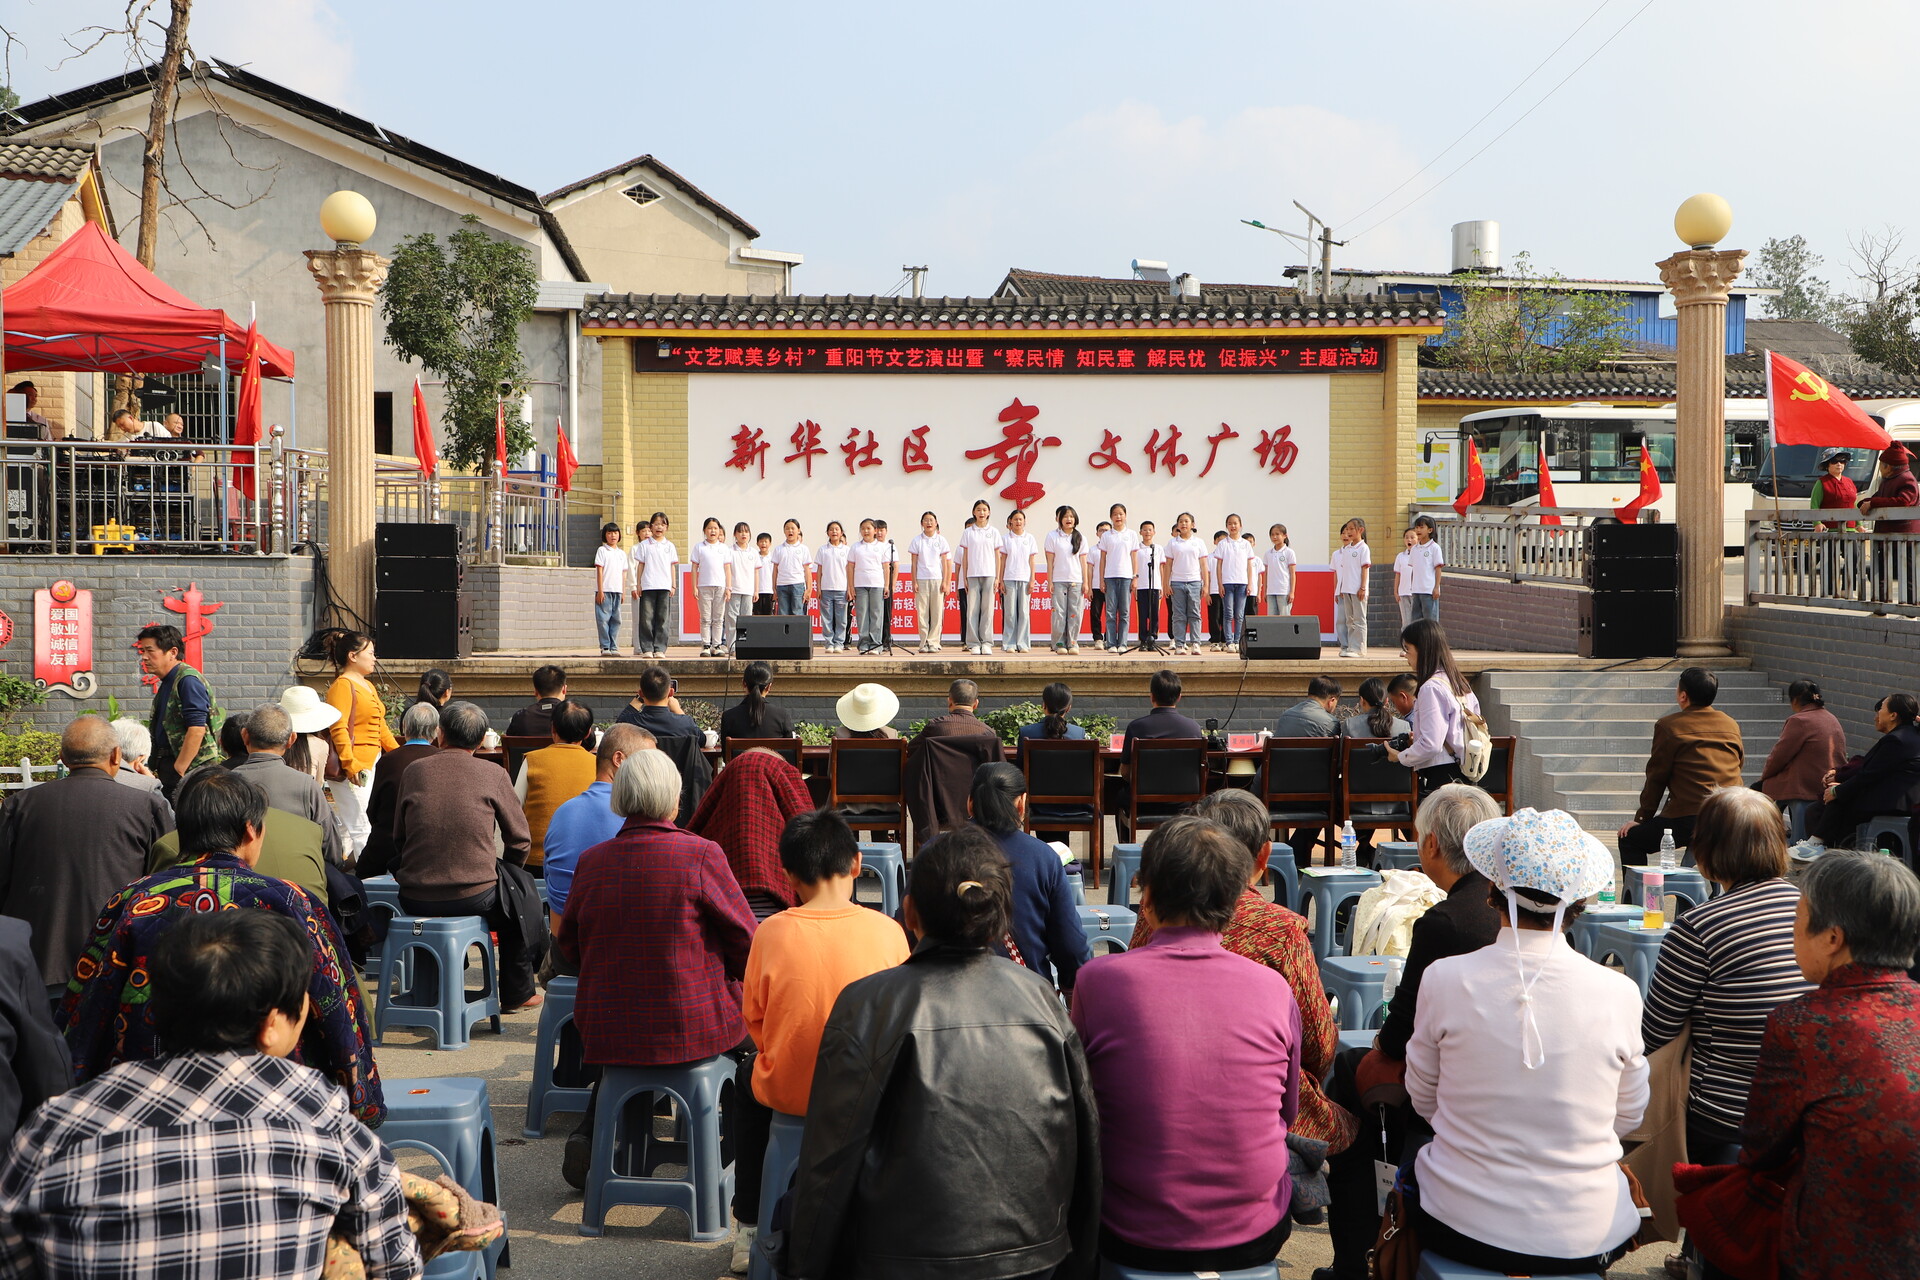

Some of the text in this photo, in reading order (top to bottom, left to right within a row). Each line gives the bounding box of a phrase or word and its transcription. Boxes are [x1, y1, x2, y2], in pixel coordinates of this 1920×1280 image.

[1077, 349, 1135, 367] 知民意
[725, 420, 932, 478] 新华社区
[1089, 424, 1298, 477] 文体广场
[50, 608, 79, 621] 爱国
[50, 623, 79, 636] 敬业
[50, 638, 79, 651] 诚信
[50, 653, 79, 666] 友善
